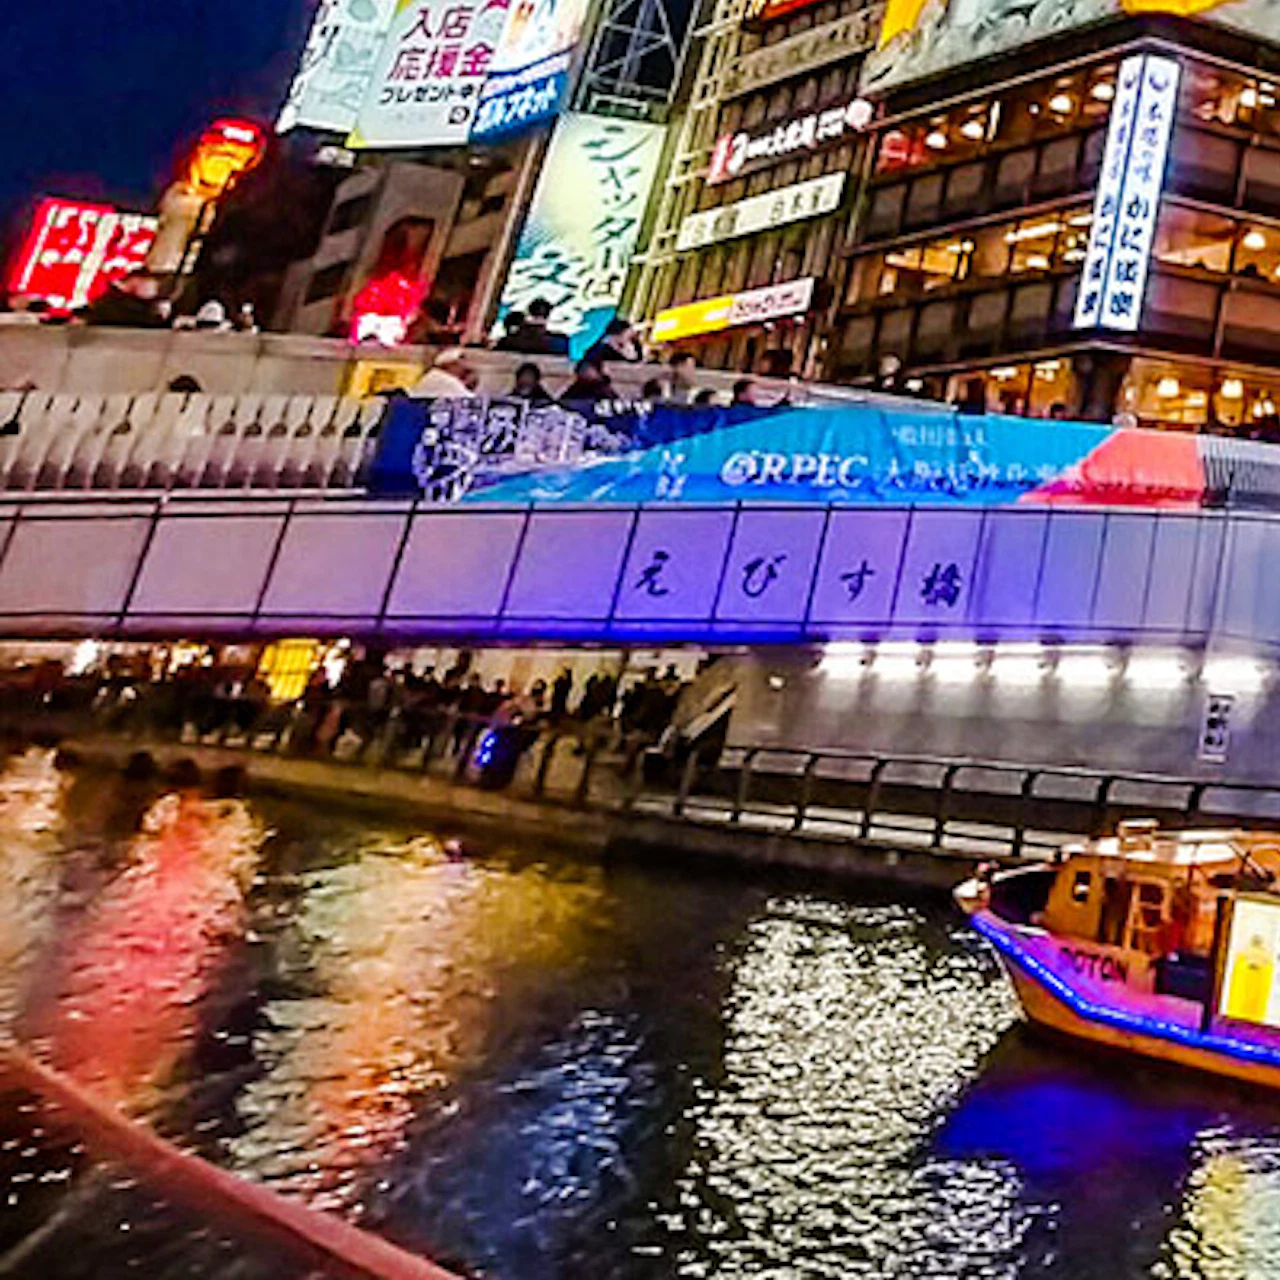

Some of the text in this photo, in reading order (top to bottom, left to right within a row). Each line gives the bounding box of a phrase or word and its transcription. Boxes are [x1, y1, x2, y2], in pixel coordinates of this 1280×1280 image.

[402, 7, 474, 41] 入店
[387, 42, 496, 81] 応援金
[634, 548, 966, 608] えびす橋
